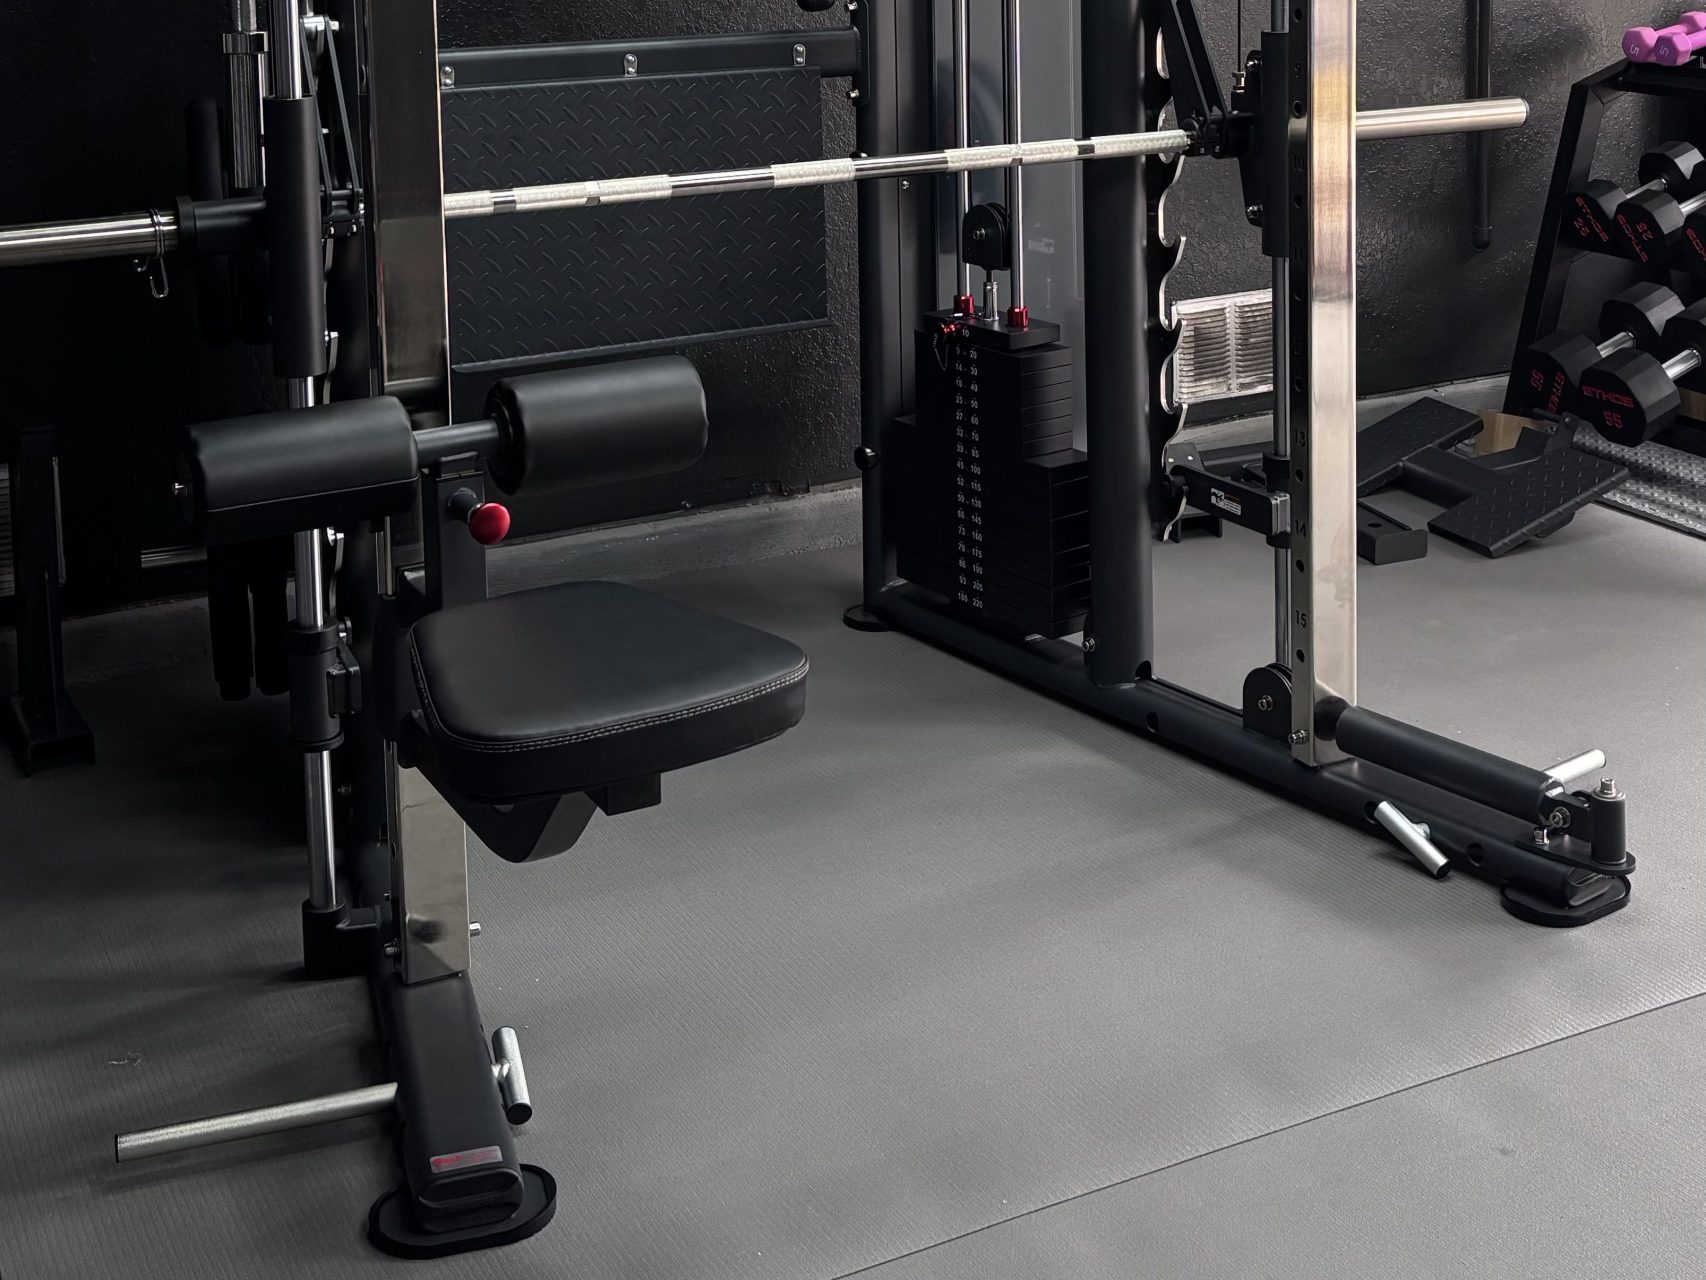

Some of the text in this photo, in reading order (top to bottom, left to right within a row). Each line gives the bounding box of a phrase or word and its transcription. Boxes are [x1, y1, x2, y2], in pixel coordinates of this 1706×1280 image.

[1630, 44, 1640, 57] 5
[1660, 45, 1670, 58] 5
[1546, 371, 1566, 414] ETHO
[1582, 385, 1634, 408] ETHOS
[1295, 519, 1307, 537] 14
[1296, 609, 1307, 628] 15
